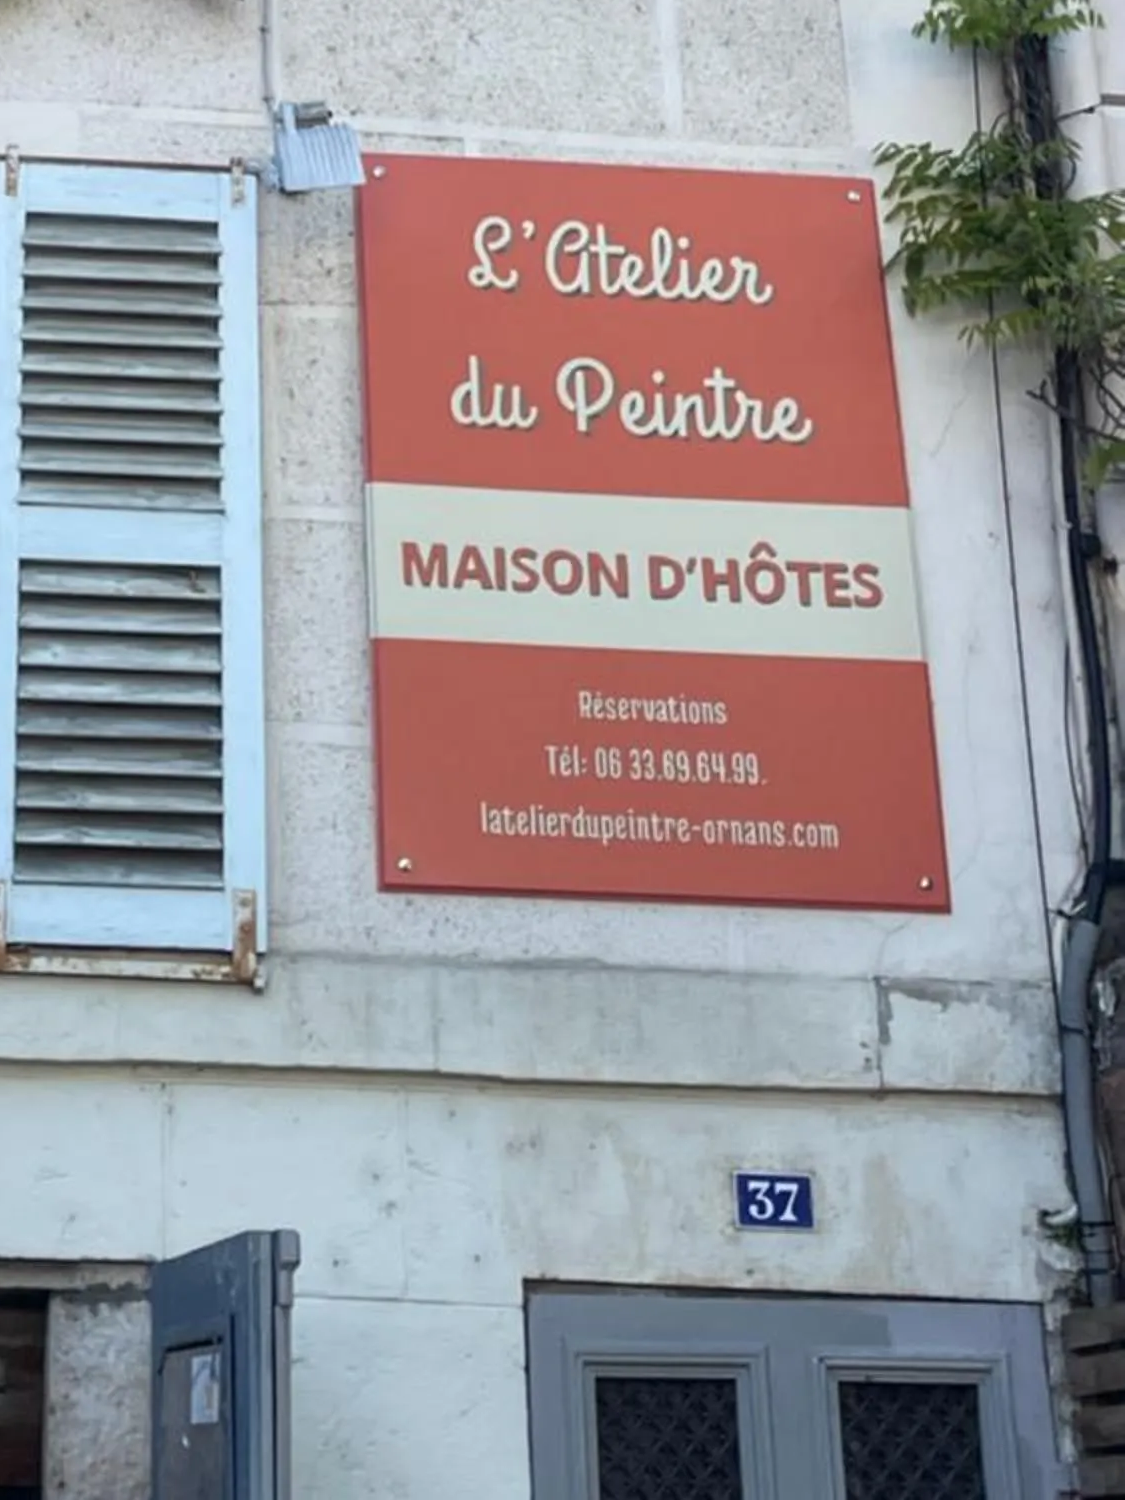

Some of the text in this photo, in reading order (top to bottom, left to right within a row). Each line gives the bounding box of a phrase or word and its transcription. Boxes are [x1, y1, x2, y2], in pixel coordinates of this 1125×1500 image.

[467, 216, 773, 304] L'Atelier
[450, 355, 813, 443] du Peintre
[401, 541, 885, 609] MAISON D'HÔTES
[578, 690, 728, 725] Réservations
[594, 746, 622, 779] 06
[480, 801, 840, 849] latelierdupeintre-ornans.com
[747, 1181, 799, 1221] 37
